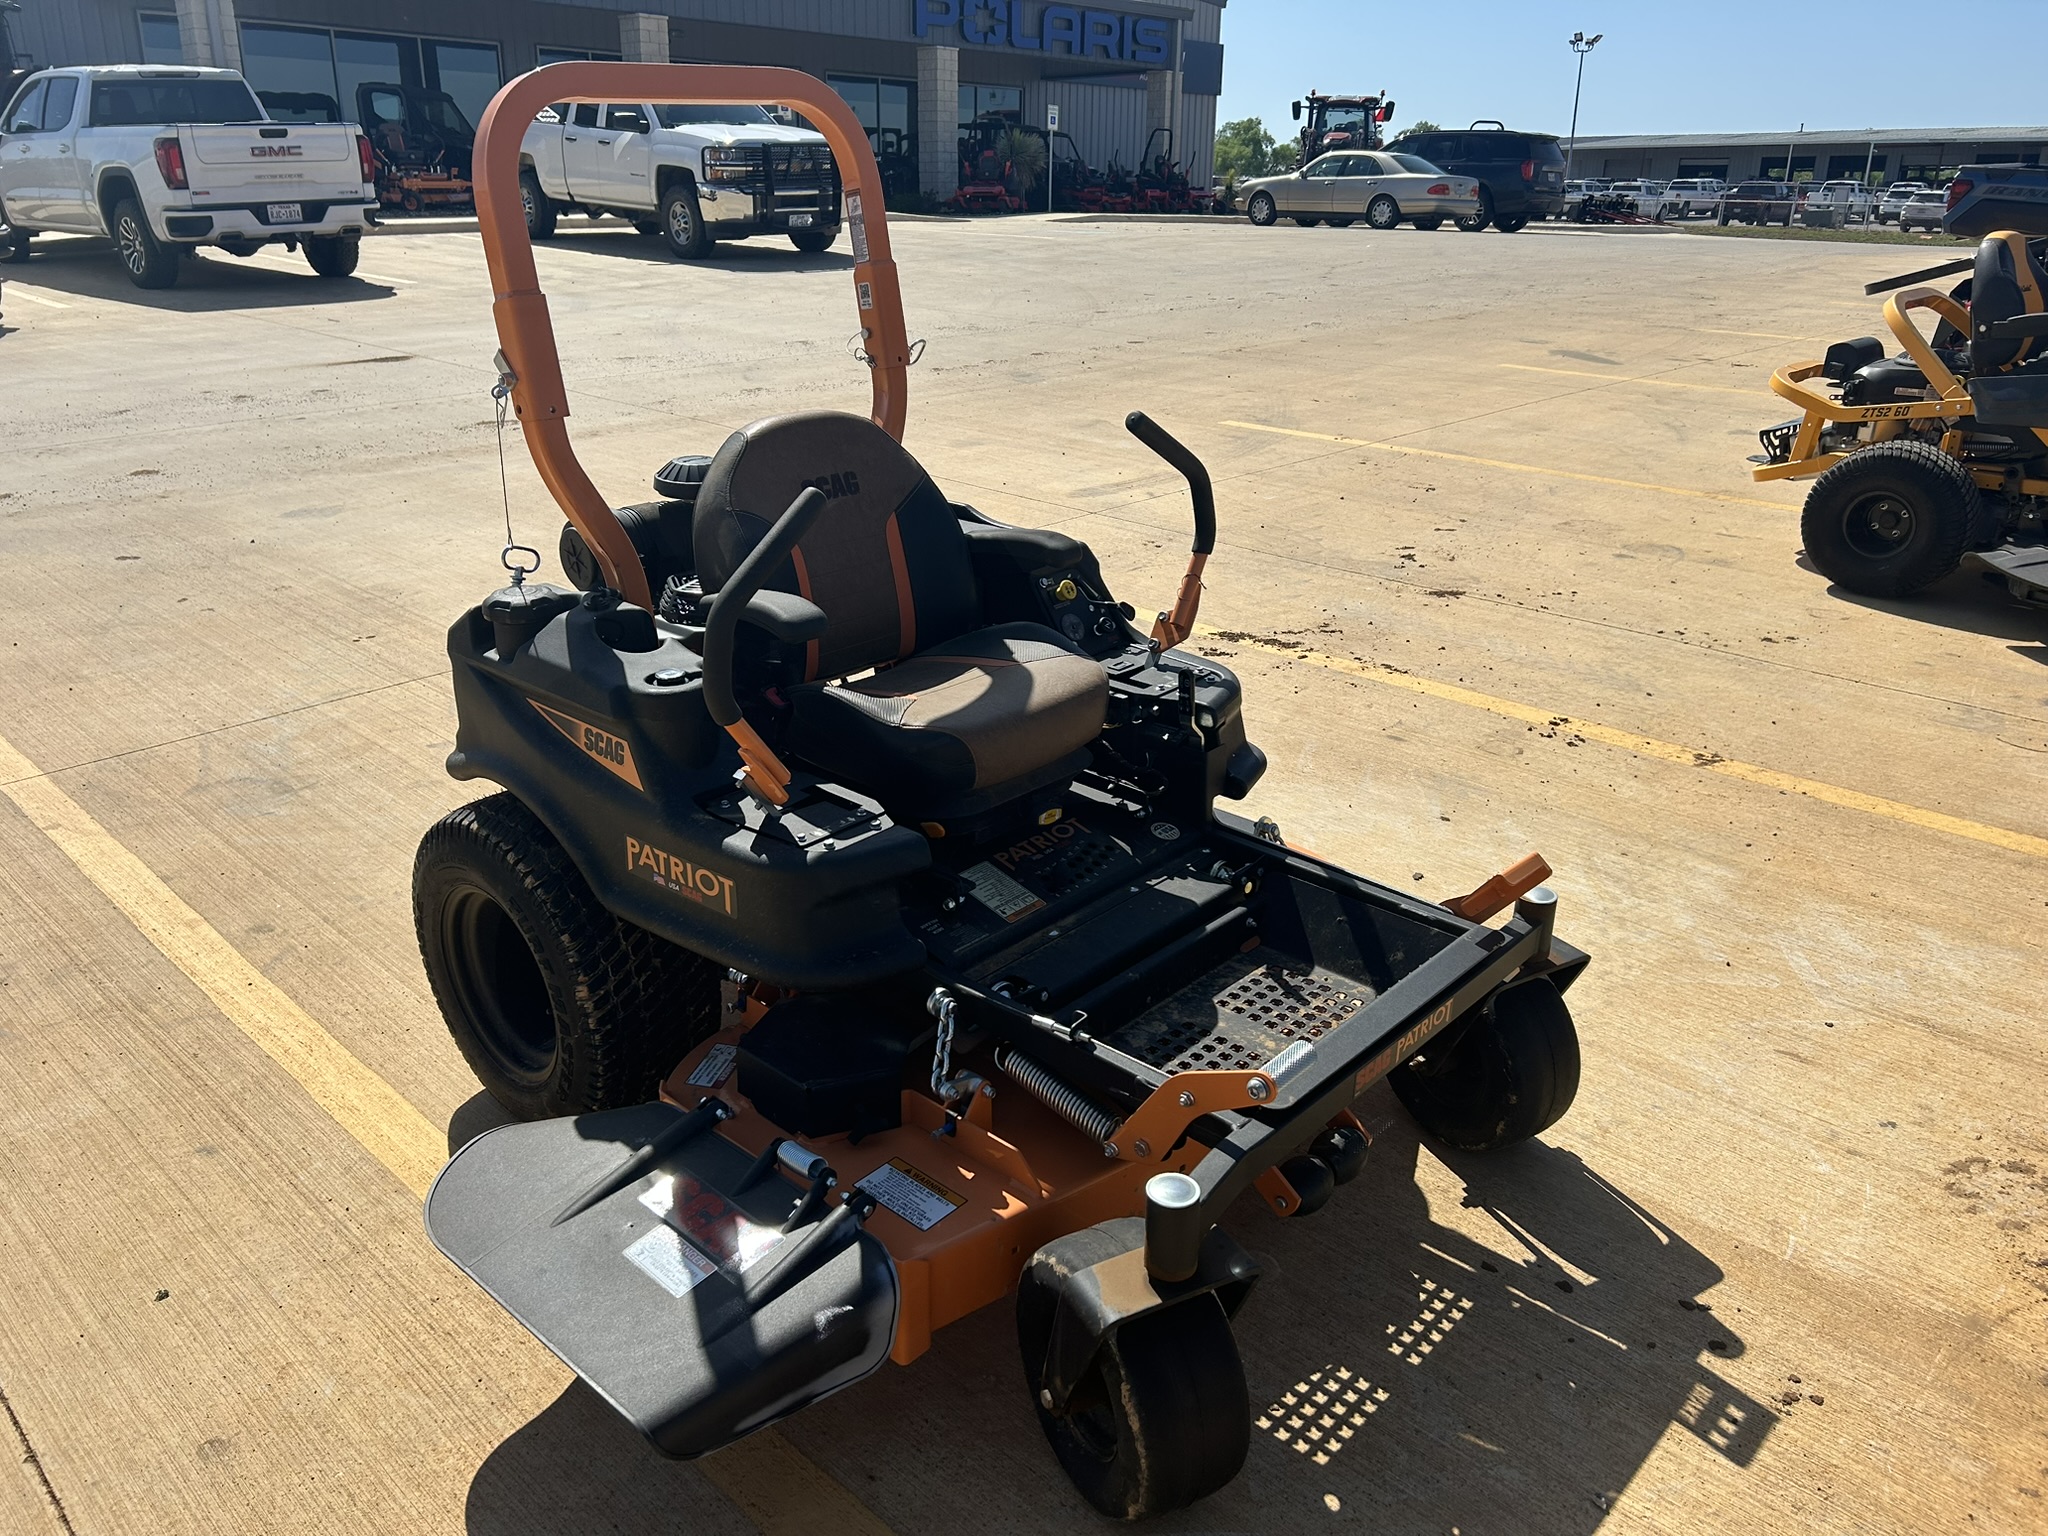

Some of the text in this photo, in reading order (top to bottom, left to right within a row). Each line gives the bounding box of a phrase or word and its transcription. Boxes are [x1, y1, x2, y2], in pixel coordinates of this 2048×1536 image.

[913, 0, 1169, 64] POLARIS
[250, 145, 303, 157] GMC
[1861, 406, 1911, 419] ZTS2 60
[583, 727, 625, 766] SCAG
[993, 817, 1093, 872] PATRIOT
[626, 836, 734, 915] PATRIOT
[668, 882, 680, 892] USA
[1395, 997, 1455, 1063] PATRIOT
[911, 1171, 949, 1197] WARNING
[925, 1190, 937, 1199] AND
[935, 1196, 950, 1207] BELTS
